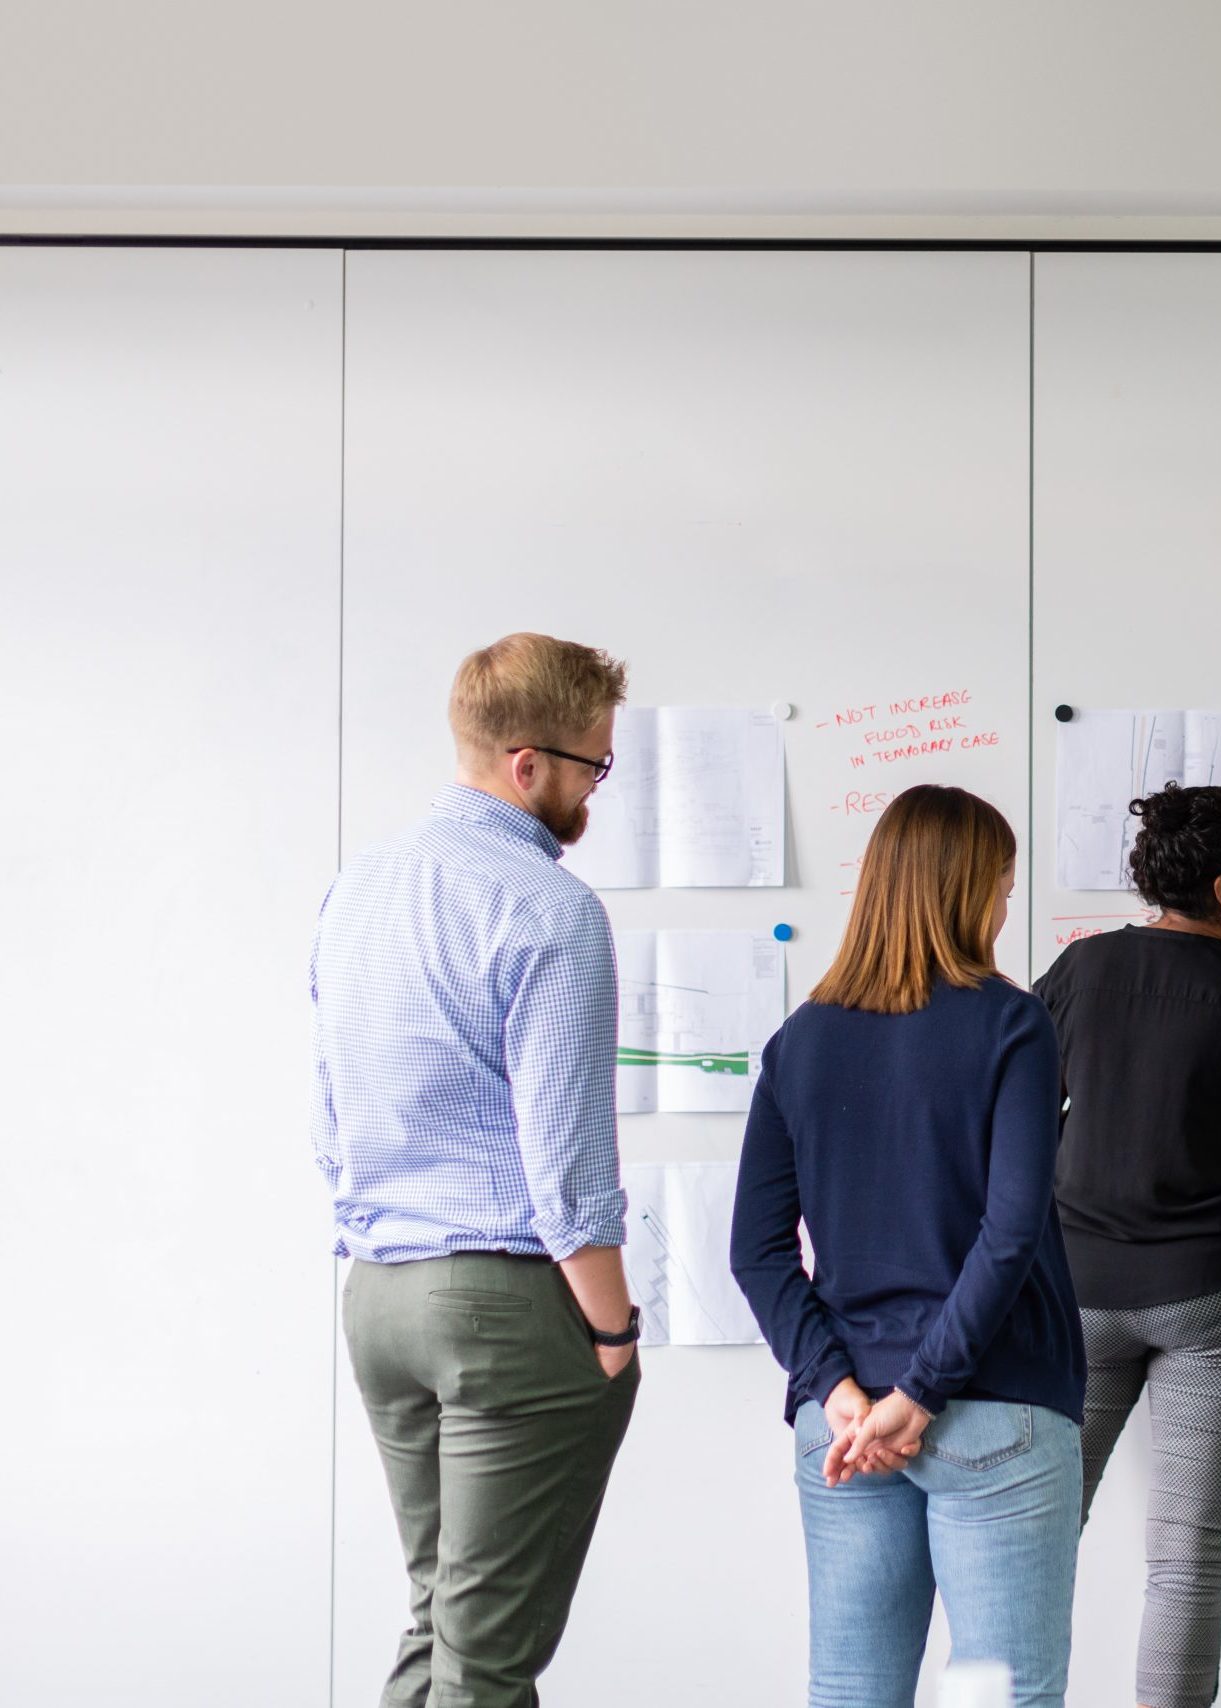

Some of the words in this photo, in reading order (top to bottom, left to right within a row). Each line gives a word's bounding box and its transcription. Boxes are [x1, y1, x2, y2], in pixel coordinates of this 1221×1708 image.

[835, 704, 877, 727] NOT
[863, 723, 922, 745] FLOOD
[929, 715, 967, 732] RISK
[850, 755, 866, 768] IN
[872, 737, 954, 762] TEMPORARY
[960, 732, 999, 749] CASE
